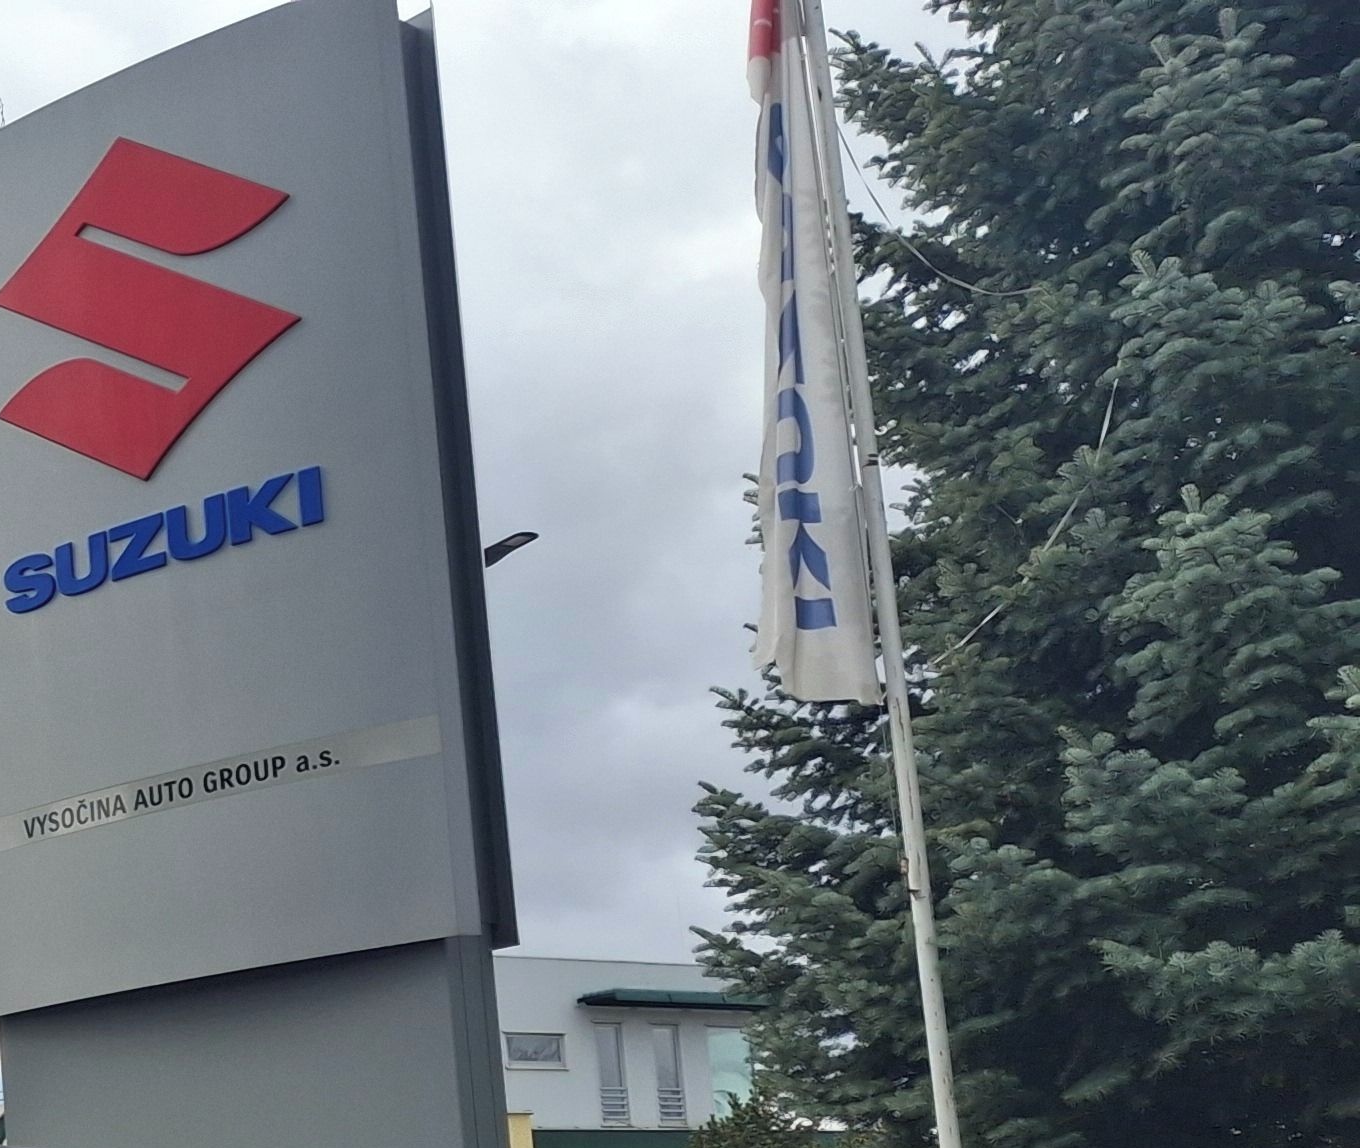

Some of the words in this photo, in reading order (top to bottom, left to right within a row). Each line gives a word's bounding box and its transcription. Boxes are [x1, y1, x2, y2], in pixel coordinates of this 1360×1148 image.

[3, 465, 325, 614] SUZUKI
[23, 793, 127, 839] VYSOČINA
[133, 777, 193, 811] AUTO
[203, 755, 286, 793] GROUP
[296, 750, 340, 773] a.s.
